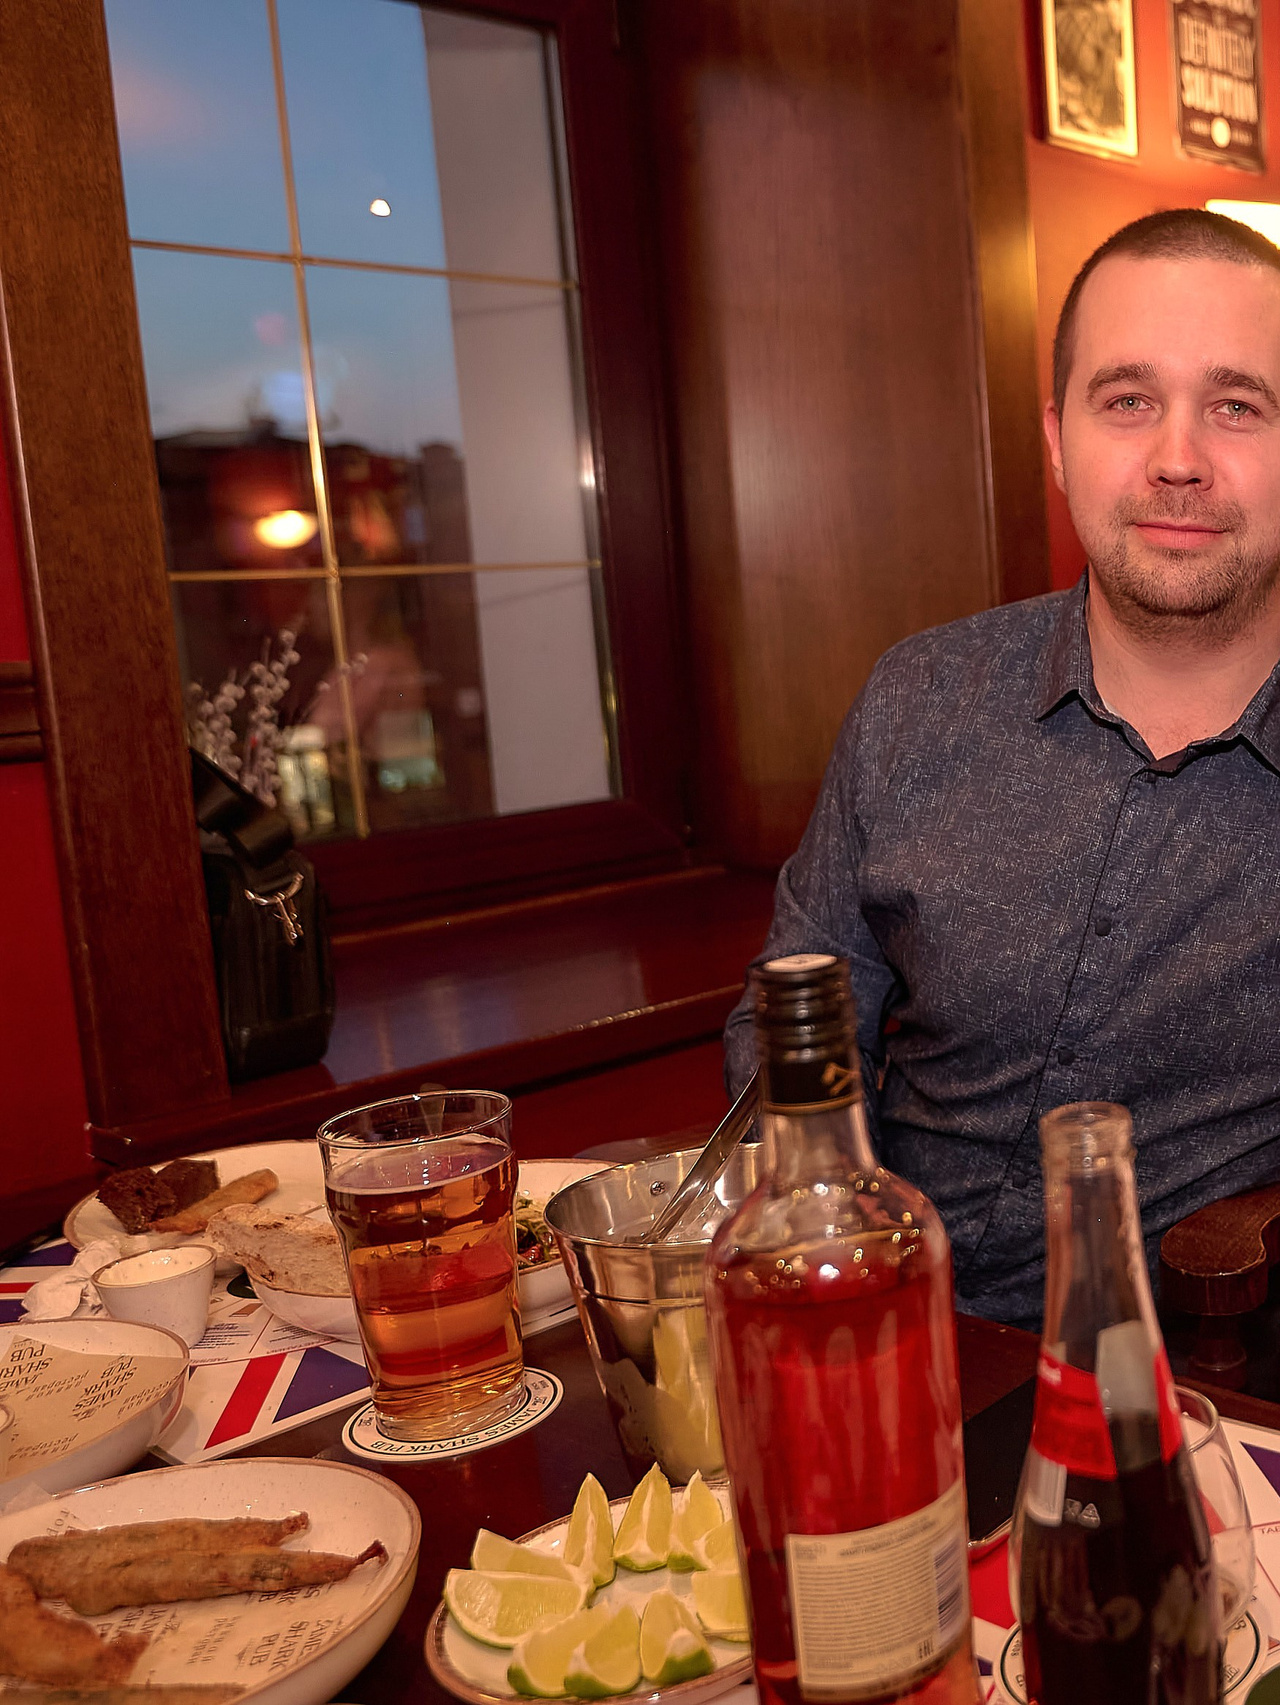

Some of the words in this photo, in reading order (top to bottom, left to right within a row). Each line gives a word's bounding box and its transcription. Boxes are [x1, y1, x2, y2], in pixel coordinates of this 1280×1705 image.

[10, 1343, 45, 1362] PUB
[100, 1357, 132, 1378] PUB
[0, 1372, 42, 1391] JAME
[80, 1366, 136, 1397] SHARK
[72, 1383, 126, 1411] JAMES
[485, 1408, 538, 1437] JAMES
[371, 1441, 408, 1452] PUB
[410, 1435, 479, 1452] SHARK
[249, 1632, 279, 1665] PUB
[268, 1620, 309, 1671] SHARK
